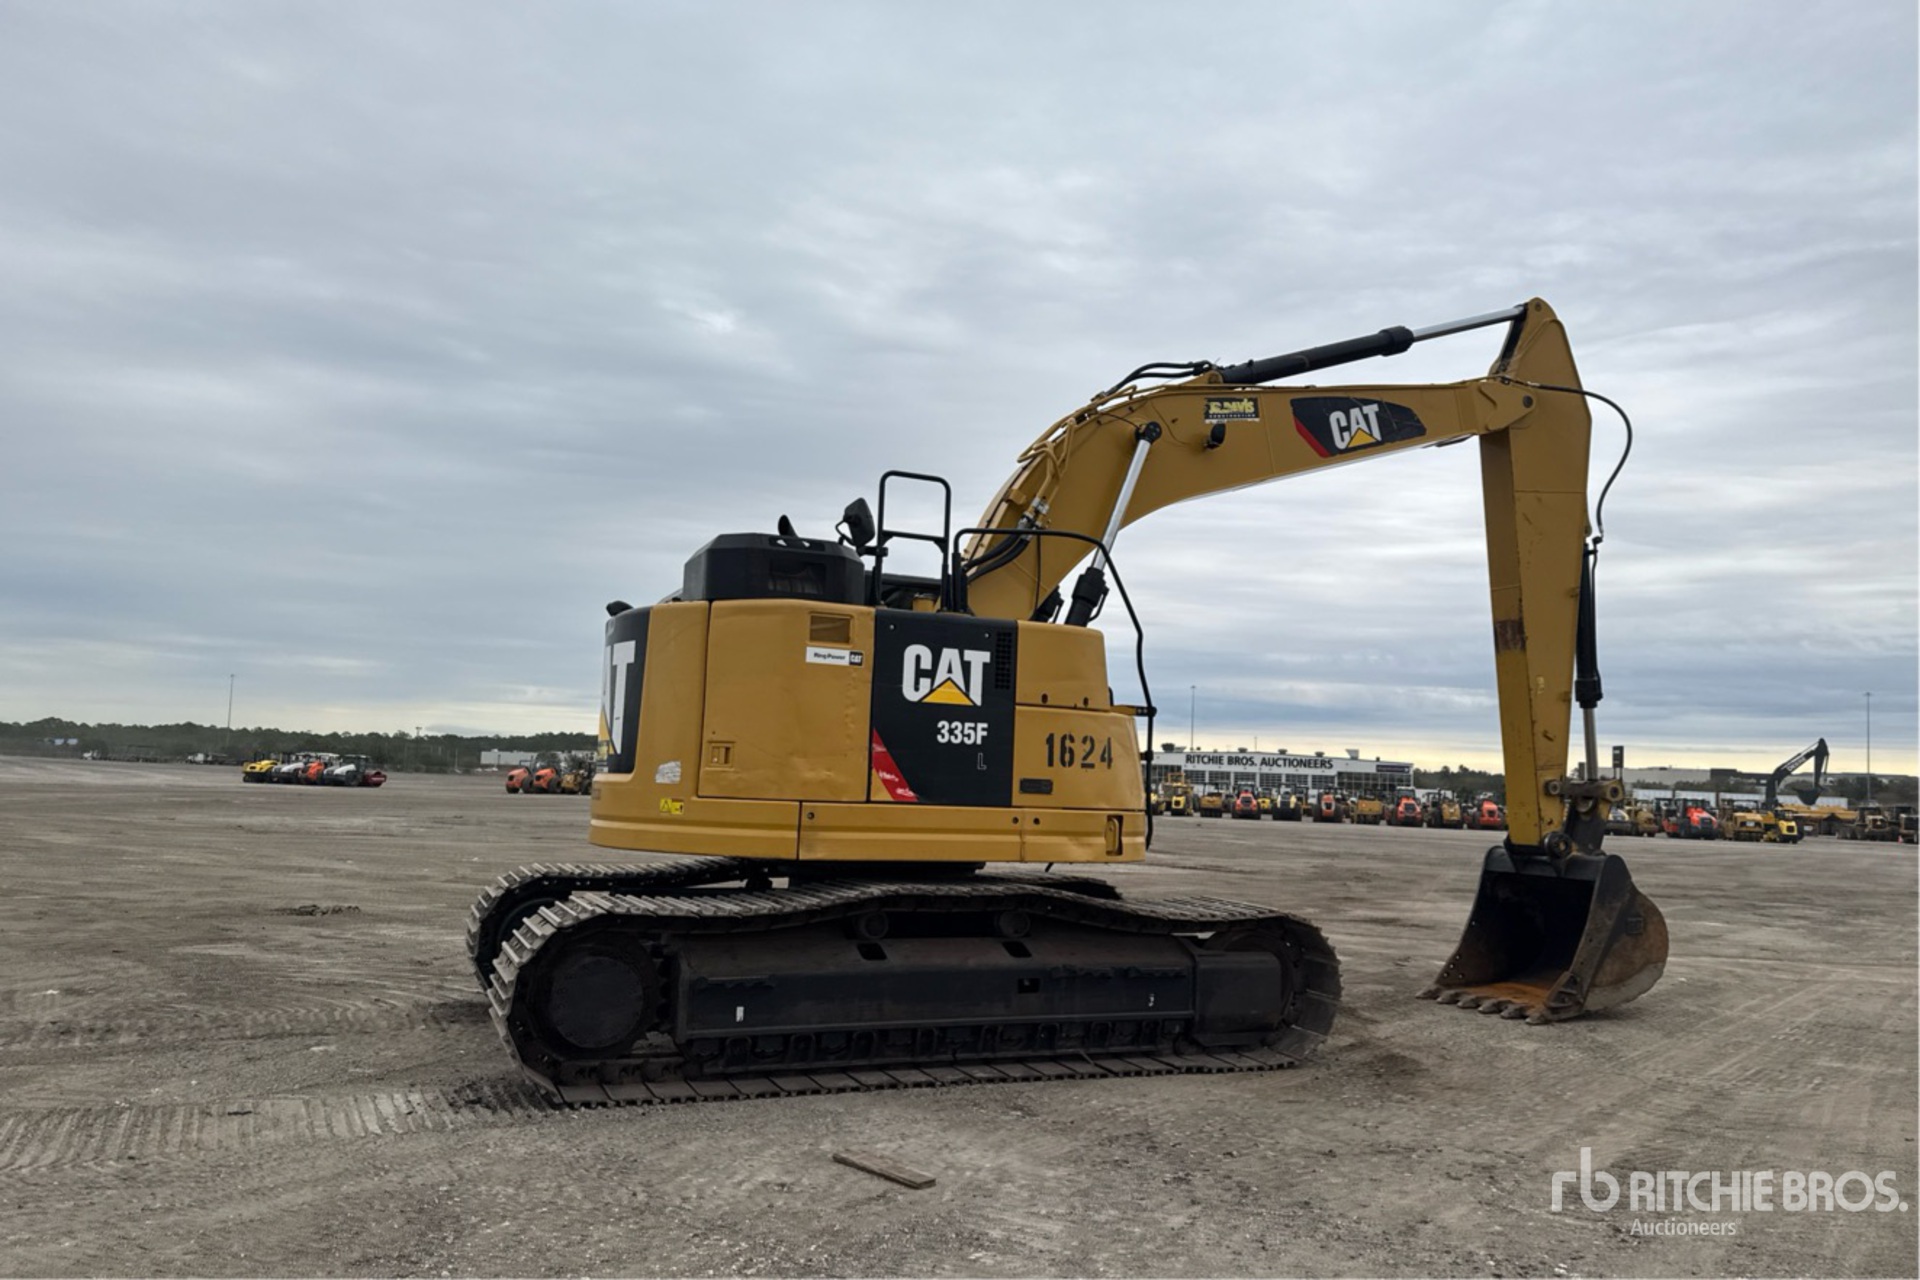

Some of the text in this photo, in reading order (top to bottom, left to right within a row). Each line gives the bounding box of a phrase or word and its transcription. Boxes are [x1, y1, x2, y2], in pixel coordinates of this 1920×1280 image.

[1329, 403, 1382, 450] CAT
[902, 644, 991, 707] CAT
[936, 720, 989, 745] 335F
[977, 753, 987, 770] L
[1045, 733, 1113, 769] 1624
[1185, 754, 1334, 769] RITCHIE BROS. AUCTIONEERS
